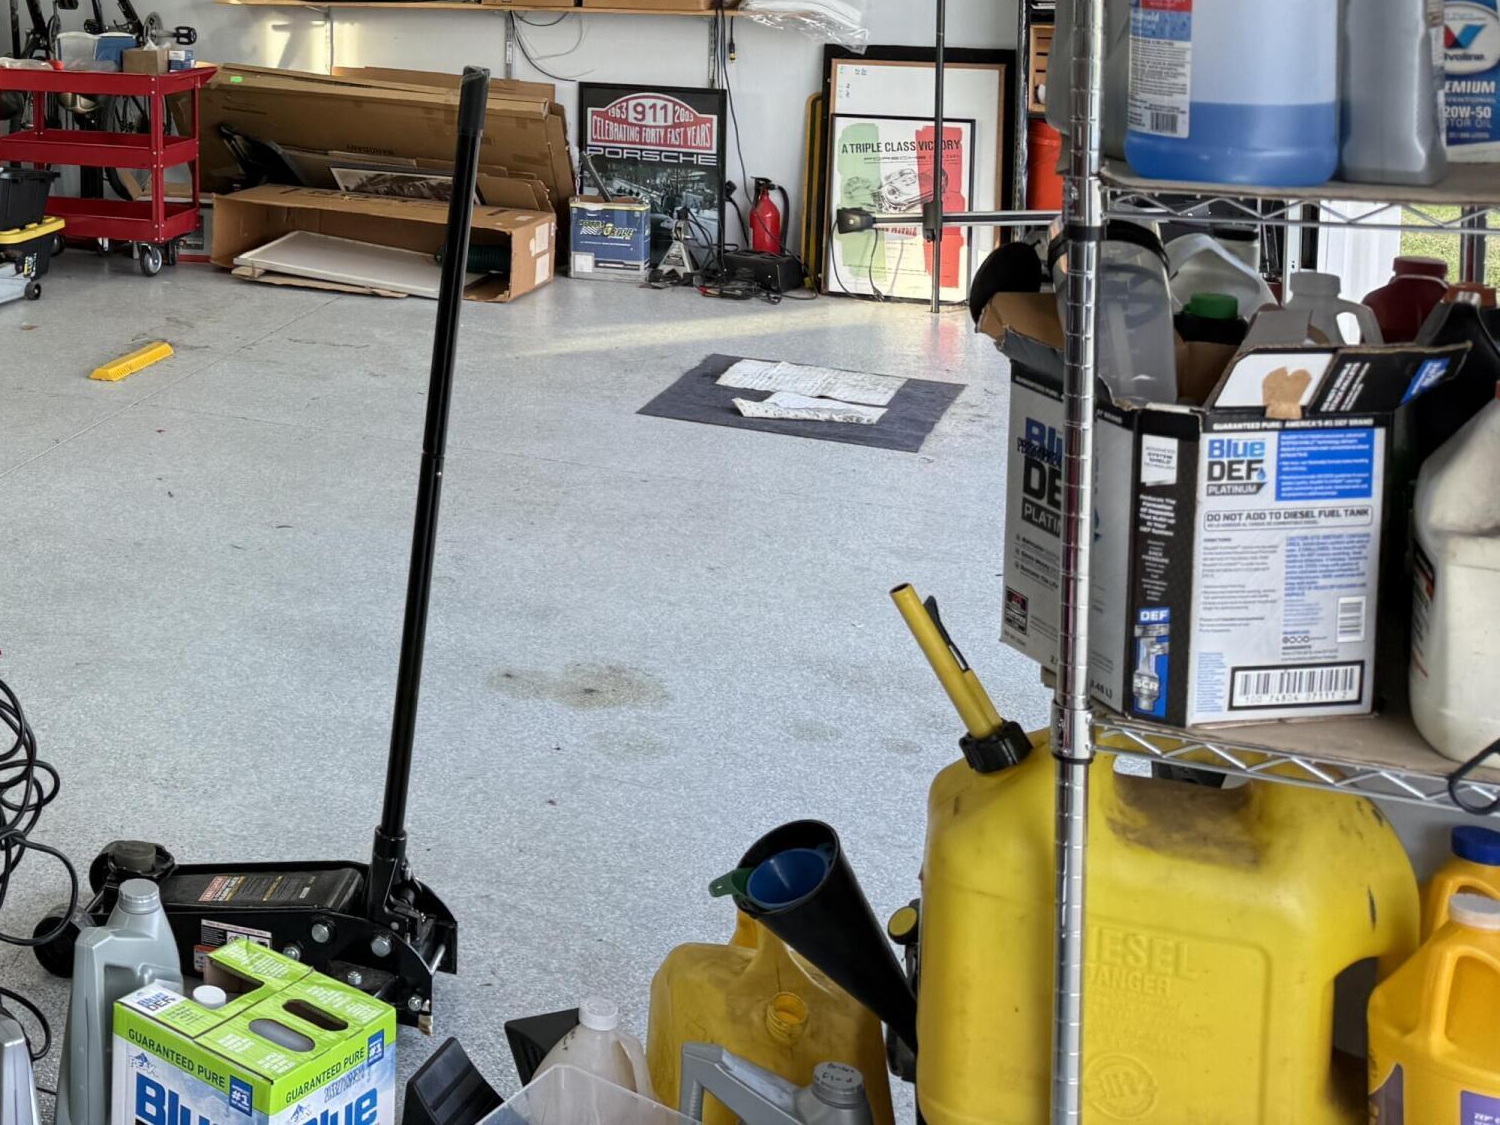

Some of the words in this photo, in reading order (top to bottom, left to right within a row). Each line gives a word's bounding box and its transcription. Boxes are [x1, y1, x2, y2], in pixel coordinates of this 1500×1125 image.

[1444, 81, 1496, 93] EMIUM
[608, 102, 627, 119] 1963
[633, 102, 668, 124] 911
[1444, 106, 1492, 118] 20W-50
[592, 115, 639, 142] CELEBRATING
[642, 126, 664, 144] FORTY
[667, 127, 684, 145] FAST
[687, 123, 711, 148] YEARS
[842, 143, 848, 154] A
[849, 142, 882, 153] TRIPLE
[885, 141, 916, 152] CLASS
[916, 139, 961, 151] VICORY
[587, 146, 717, 166] PORSCHE
[1213, 421, 1260, 431] GUARANTEED
[1208, 438, 1266, 459] Blue
[1207, 459, 1264, 482] DEF
[1023, 455, 1061, 511] DE
[1208, 485, 1257, 495] PLATINUM
[1024, 503, 1060, 533] PLATI
[1207, 513, 1221, 522] DO
[1223, 513, 1243, 521] NOT
[1245, 512, 1267, 520] ADD
[1269, 511, 1281, 520] TO
[1284, 510, 1316, 519] DIESEL
[1318, 509, 1341, 518] FUEL
[1344, 508, 1369, 517] TANK
[1140, 610, 1167, 622] DEF
[1134, 677, 1157, 692] SCR
[147, 996, 176, 1012] DEF
[128, 1028, 194, 1072] GUARANTEED
[197, 1065, 225, 1088] PURE
[285, 1062, 341, 1103] GUARANTEED
[343, 1047, 365, 1068] PURE
[231, 1089, 249, 1106] #1
